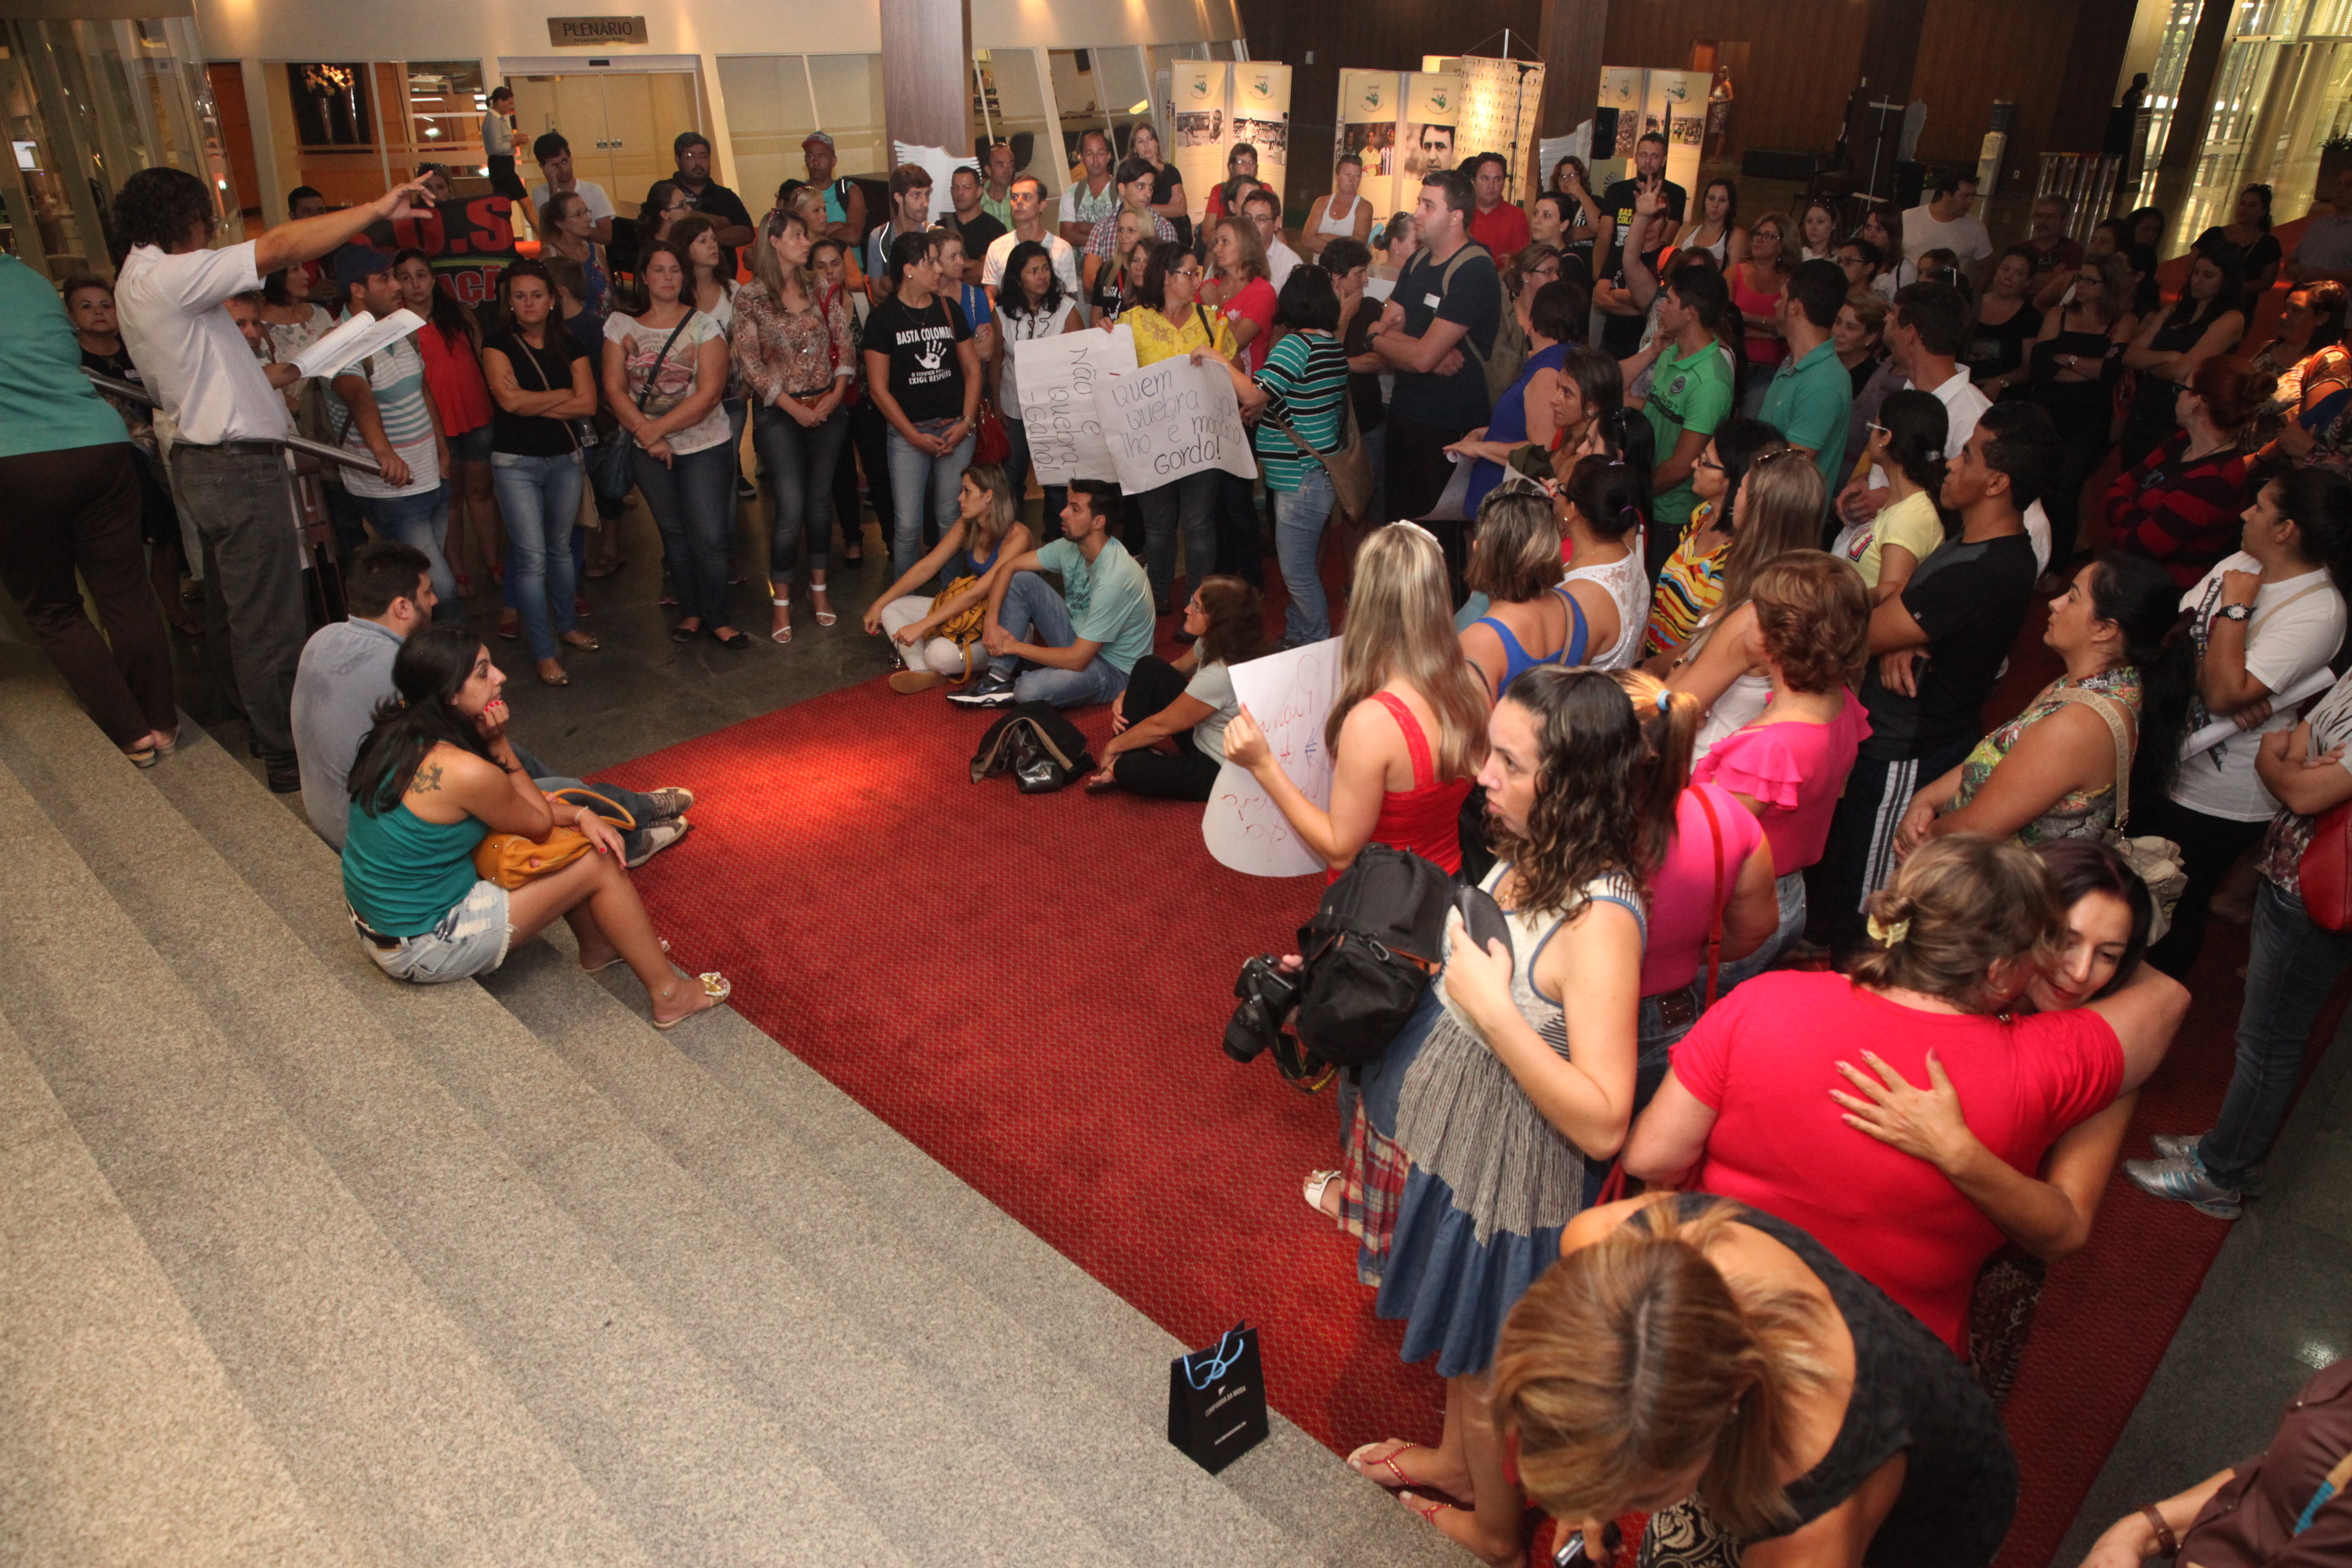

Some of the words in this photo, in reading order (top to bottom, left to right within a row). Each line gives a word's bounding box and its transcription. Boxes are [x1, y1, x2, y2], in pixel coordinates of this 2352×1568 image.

[563, 18, 633, 36] PLENÁRIO
[1617, 216, 1632, 225] COL
[1618, 208, 1632, 217] BAS
[896, 329, 921, 346] BASTA
[908, 376, 928, 385] EXIGE
[928, 370, 952, 383] RESPEITO
[1069, 347, 1097, 395] Não
[1120, 432, 1152, 459] lho
[1154, 433, 1222, 475] Gordo!
